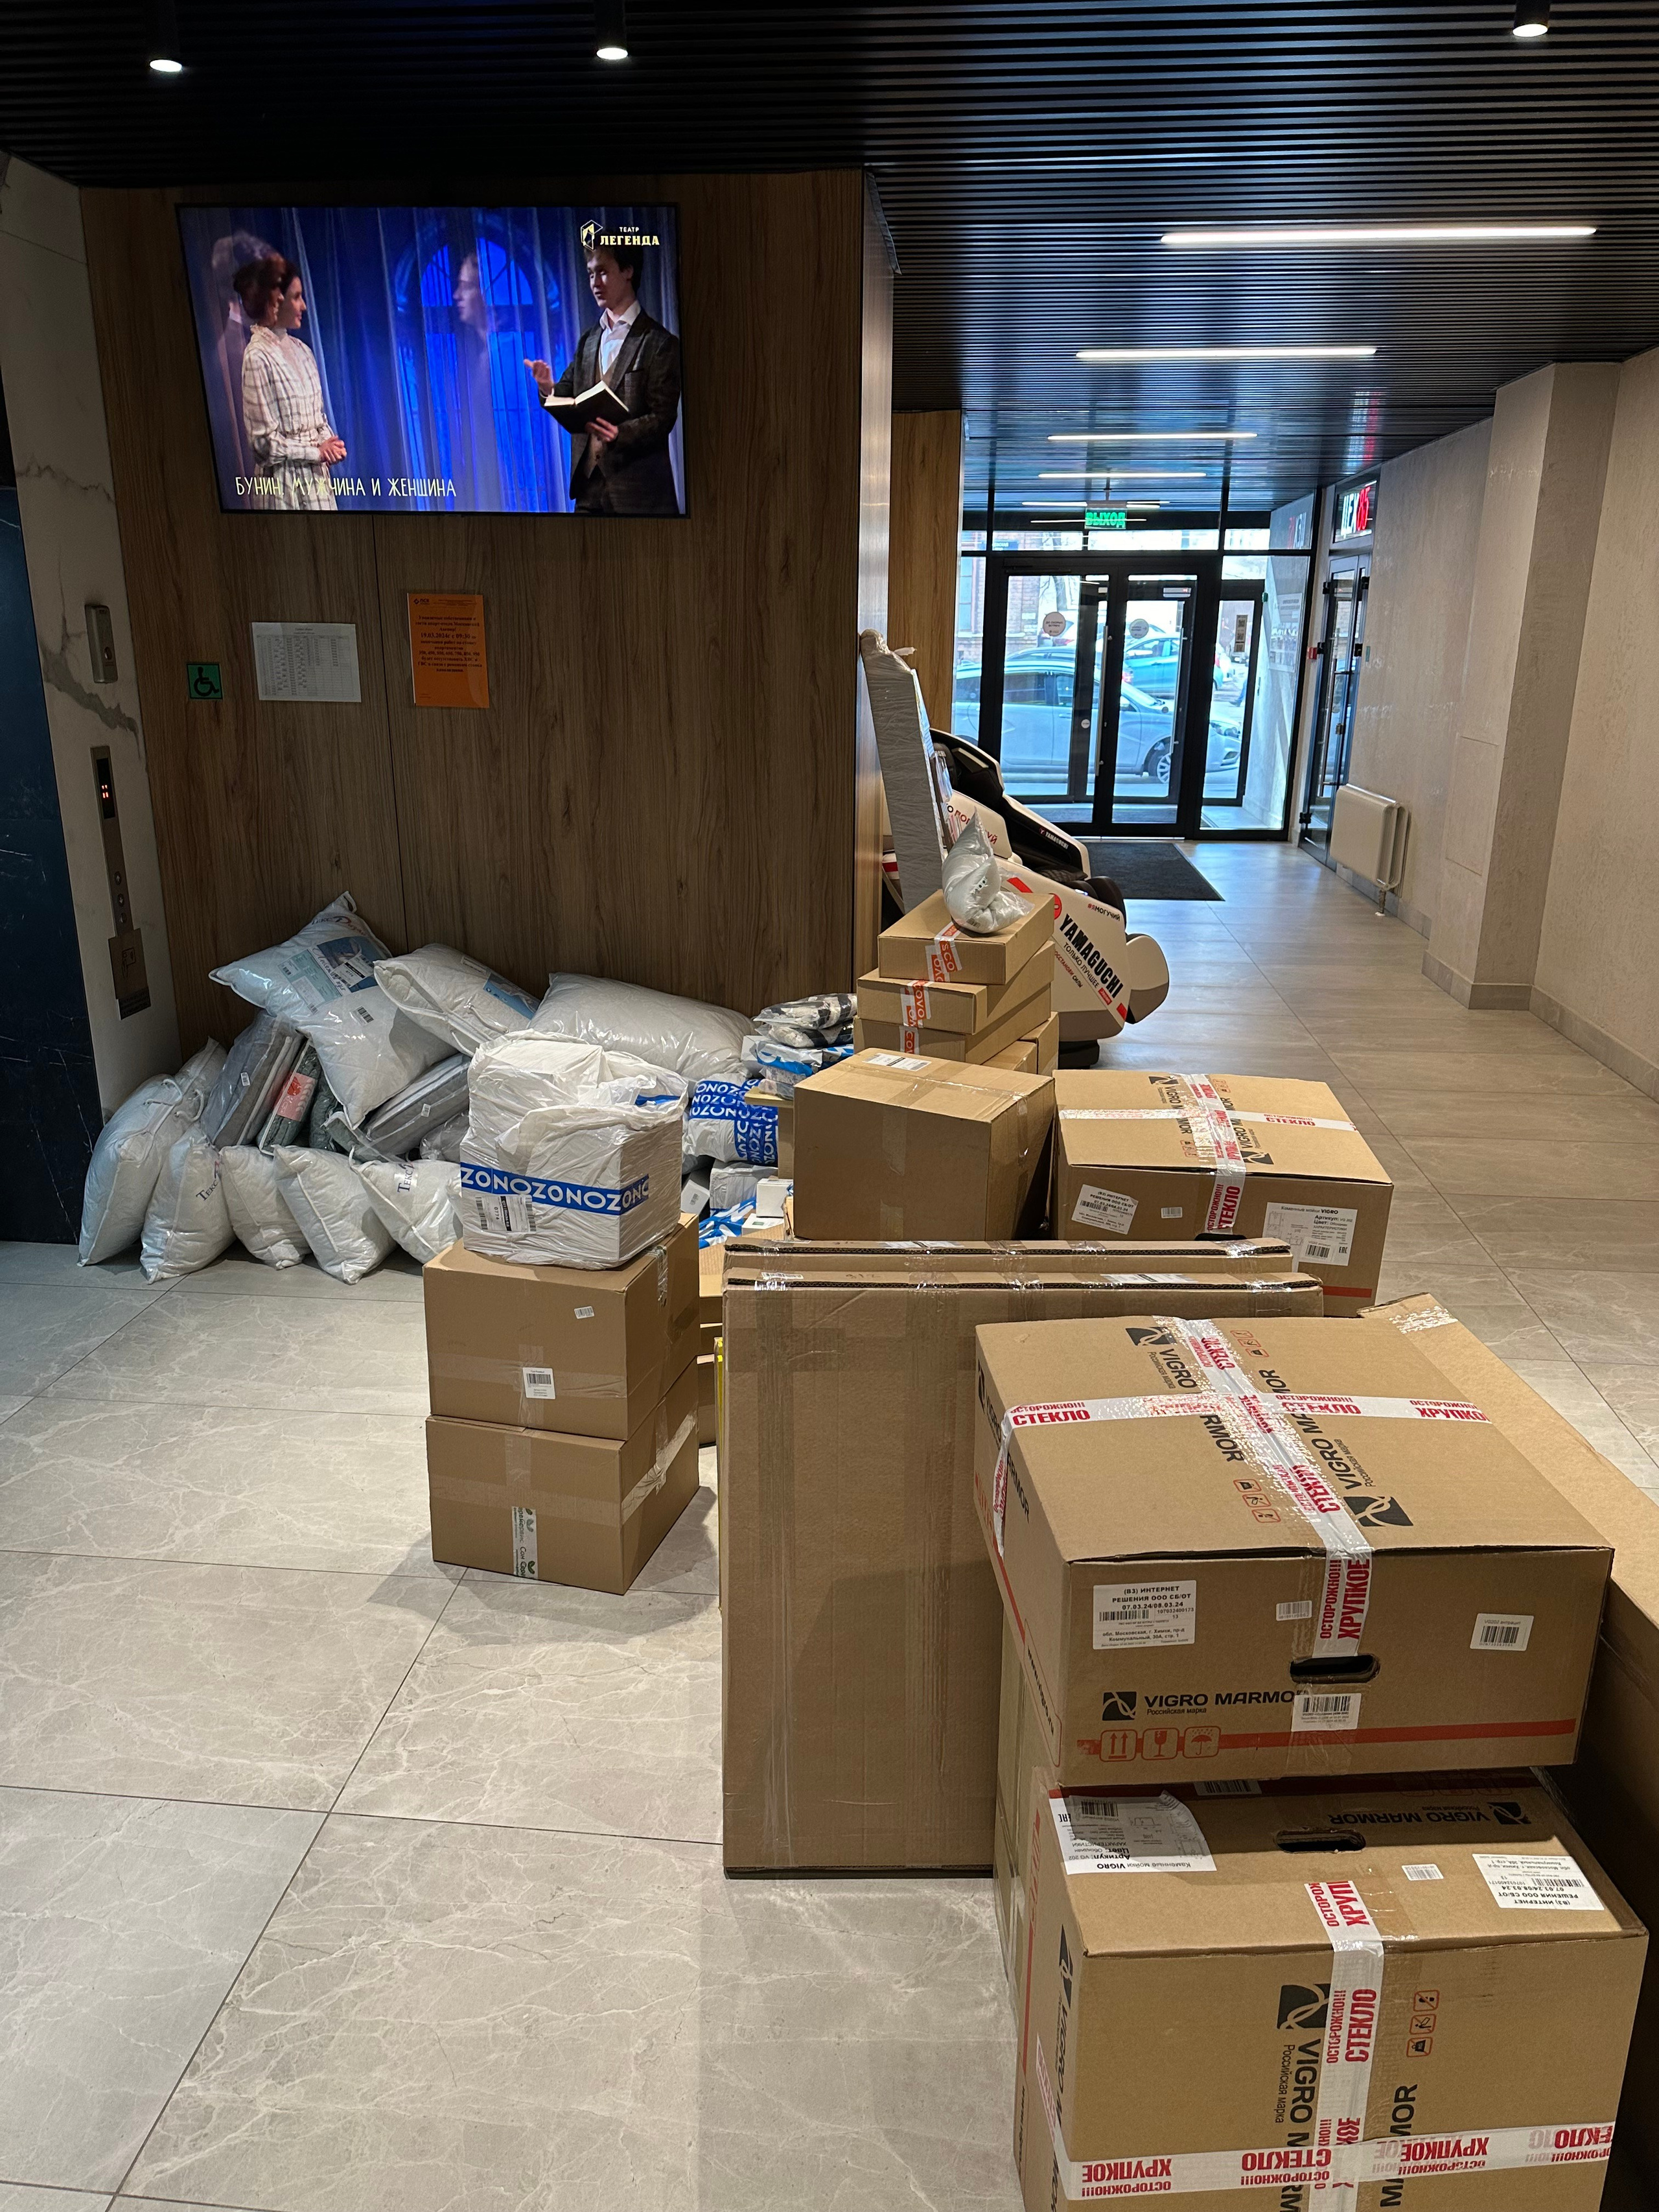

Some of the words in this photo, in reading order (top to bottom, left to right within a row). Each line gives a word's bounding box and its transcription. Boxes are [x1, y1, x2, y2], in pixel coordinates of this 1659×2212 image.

[599, 235, 660, 246] ЛЕГЕНДА
[292, 478, 365, 496] МУЖЧИНА
[371, 478, 381, 496] И
[388, 478, 456, 496] ЖЕНЩИНА
[1085, 512, 1126, 528] ВЫХОД
[1087, 903, 1120, 921] #ЯМОГУЧИЙ
[1060, 913, 1124, 999] YAMAGUCHI
[1063, 942, 1082, 966] ТОЛЬКО
[1080, 964, 1100, 988] ЛУЧШЕЕ
[1054, 950, 1074, 976] ОССТАНОВИ
[1072, 975, 1083, 988] СИЛЫ
[1165, 1086, 1181, 1104] VIGRO
[1266, 1116, 1316, 1126] СТЕКЛО
[1159, 1349, 1198, 1388] VIGRO
[1282, 1401, 1362, 1415] СТЕКЛО
[1012, 1409, 1091, 1426] СТЕКЛО
[1311, 1438, 1362, 1490] VIGRO
[1122, 1602, 1183, 1611] 07.03.24/08.03.24
[1320, 1559, 1341, 1639] ОСТОРОЖНО!!!
[1338, 1558, 1370, 1640] ХРУПКОЕ
[1144, 1695, 1209, 1708] VIGRO
[1187, 1707, 1207, 1716] марка
[1328, 1812, 1422, 1824] MARMOR
[1426, 1811, 1491, 1822] VIGRO
[1326, 1989, 1346, 2064] ОСТОРОЖНО!!!
[1345, 1988, 1377, 2062] СТЕКЛО
[1278, 2044, 1295, 2095] Российская
[1289, 2038, 1321, 2124] VIGRO
[1275, 2097, 1287, 2123] марка
[1400, 2137, 1490, 2162] ХРУПКОЕ
[1240, 2148, 1332, 2172] СТЕКЛО
[1398, 2158, 1487, 2175] ОСТОРОЖНО!!!
[1082, 2158, 1173, 2183] ХРУПКОЕ
[1240, 2171, 1331, 2186] ОСТОРОЖНО!!!
[1081, 2180, 1172, 2197] ОСТОРОЖНО!!!
